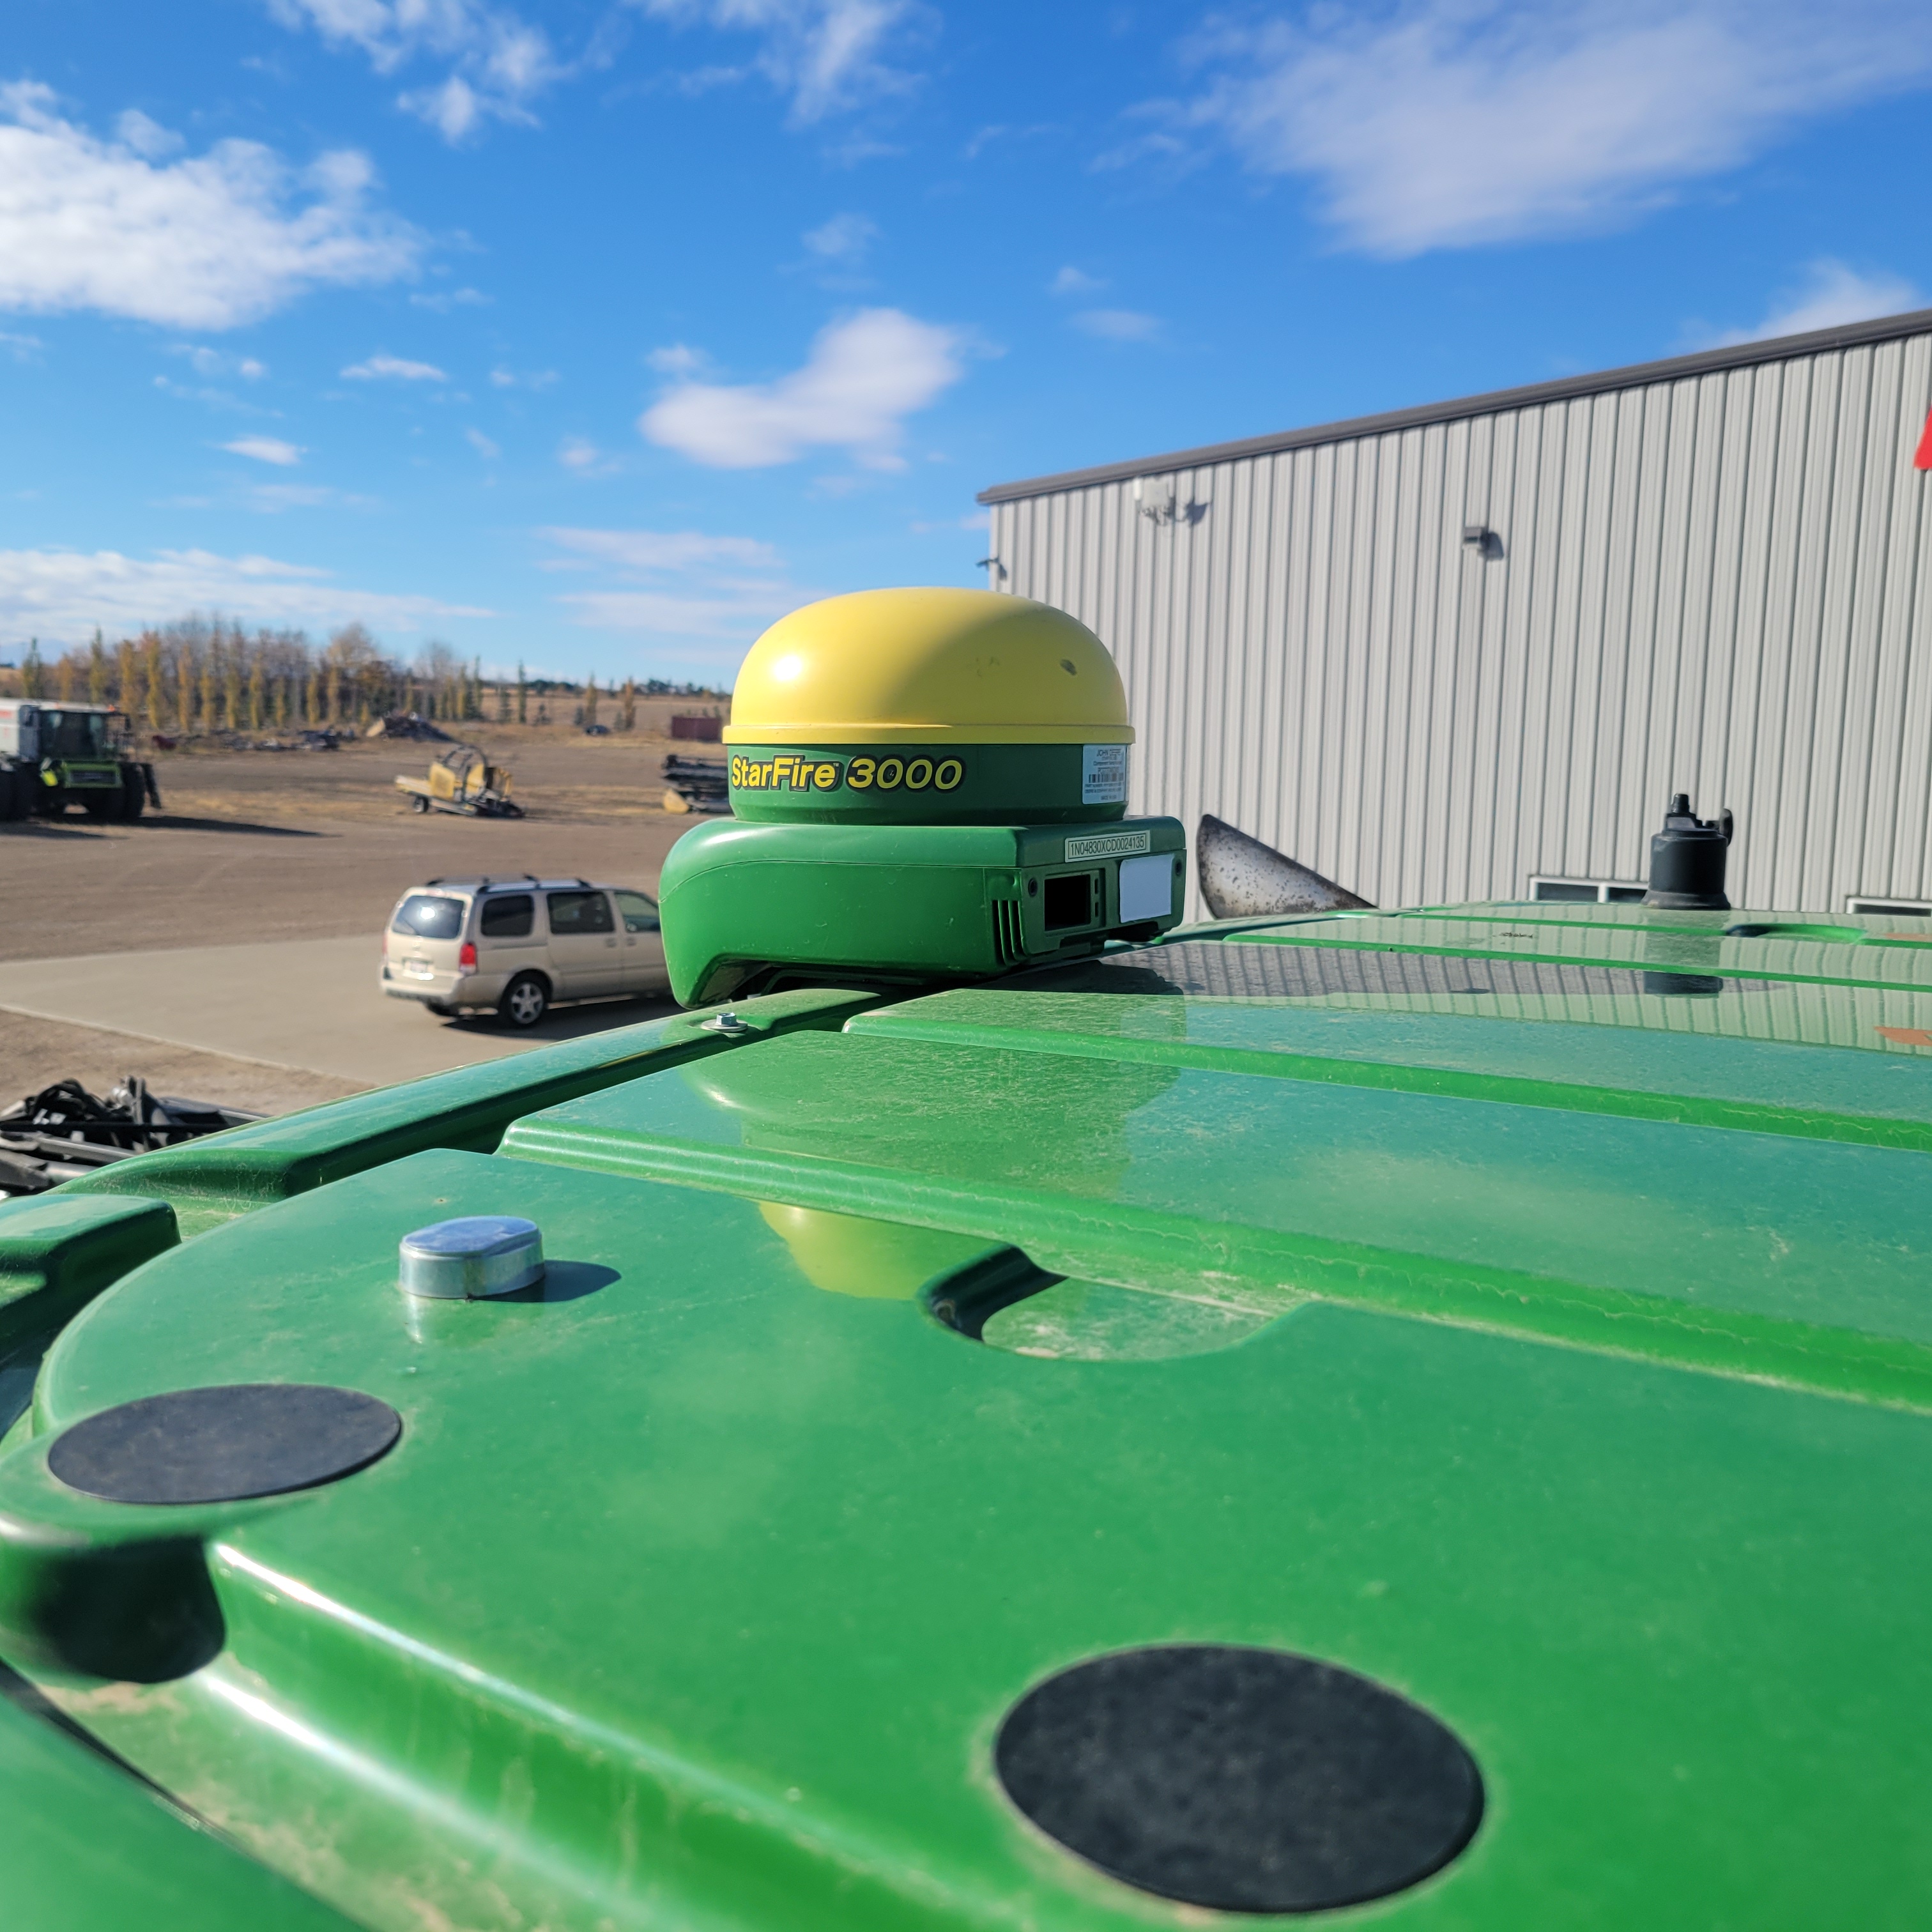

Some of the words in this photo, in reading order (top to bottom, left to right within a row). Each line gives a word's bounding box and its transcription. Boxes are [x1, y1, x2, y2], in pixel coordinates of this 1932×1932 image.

[731, 756, 836, 788] StarFire
[848, 758, 963, 790] 3000
[1070, 835, 1145, 856] 1N04830XCD0024135
